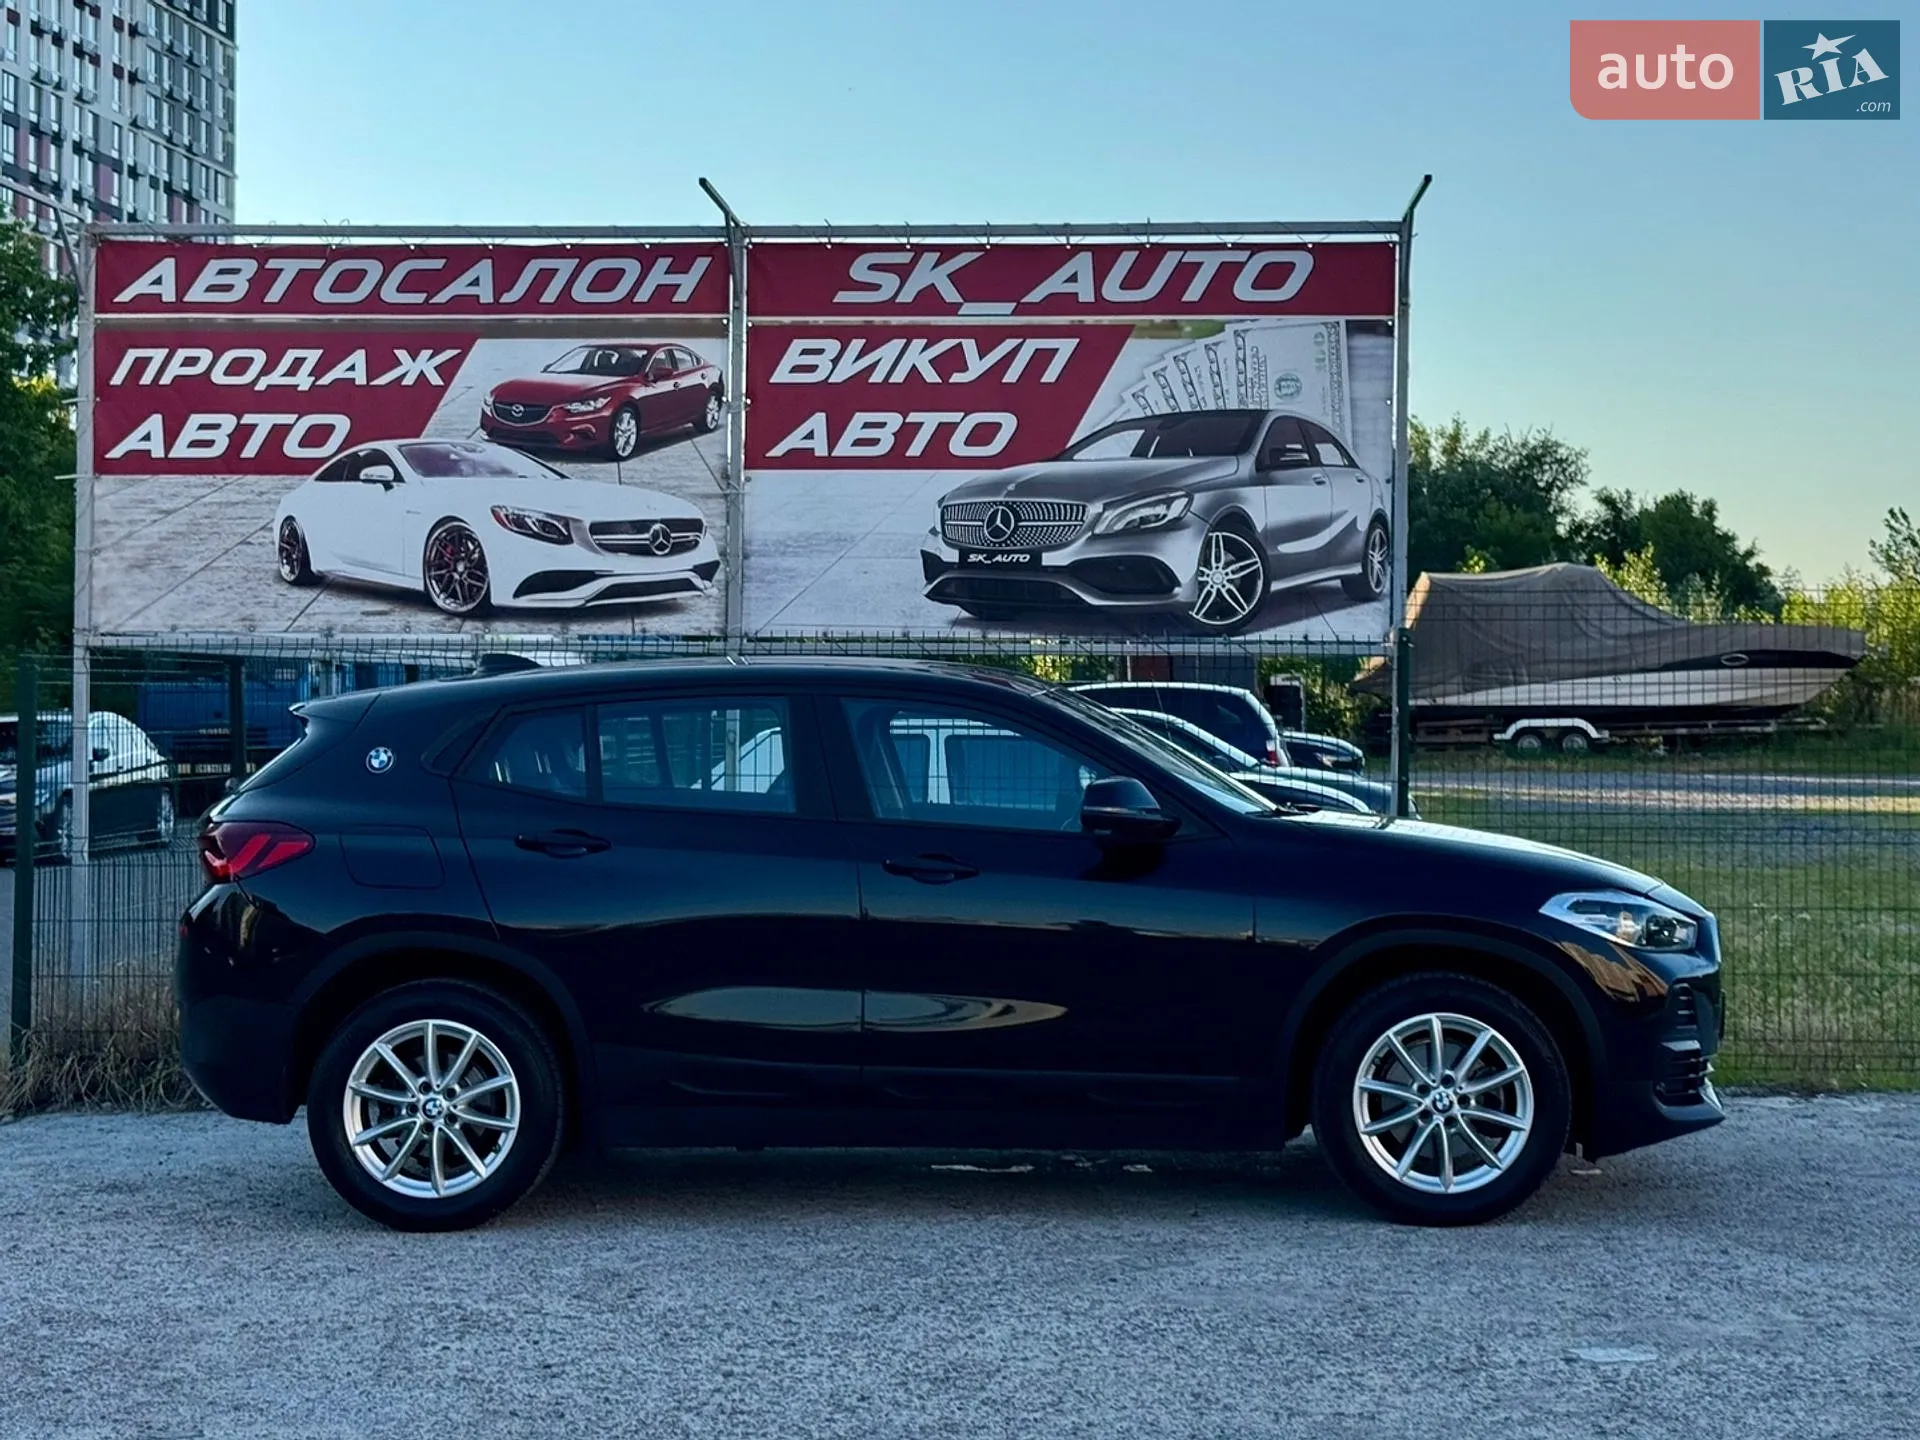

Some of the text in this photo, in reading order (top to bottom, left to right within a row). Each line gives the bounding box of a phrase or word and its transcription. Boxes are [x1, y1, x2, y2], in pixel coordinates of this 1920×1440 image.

[113, 257, 712, 304] АВТОСАЛОН
[832, 250, 1314, 315] SK_AUTO
[109, 347, 462, 392] ПРОДАЖ
[769, 338, 1080, 383] ВИКУП
[104, 413, 351, 459] АВТО
[765, 411, 1018, 457] АВТО
[967, 553, 1031, 564] SK_AUTO
